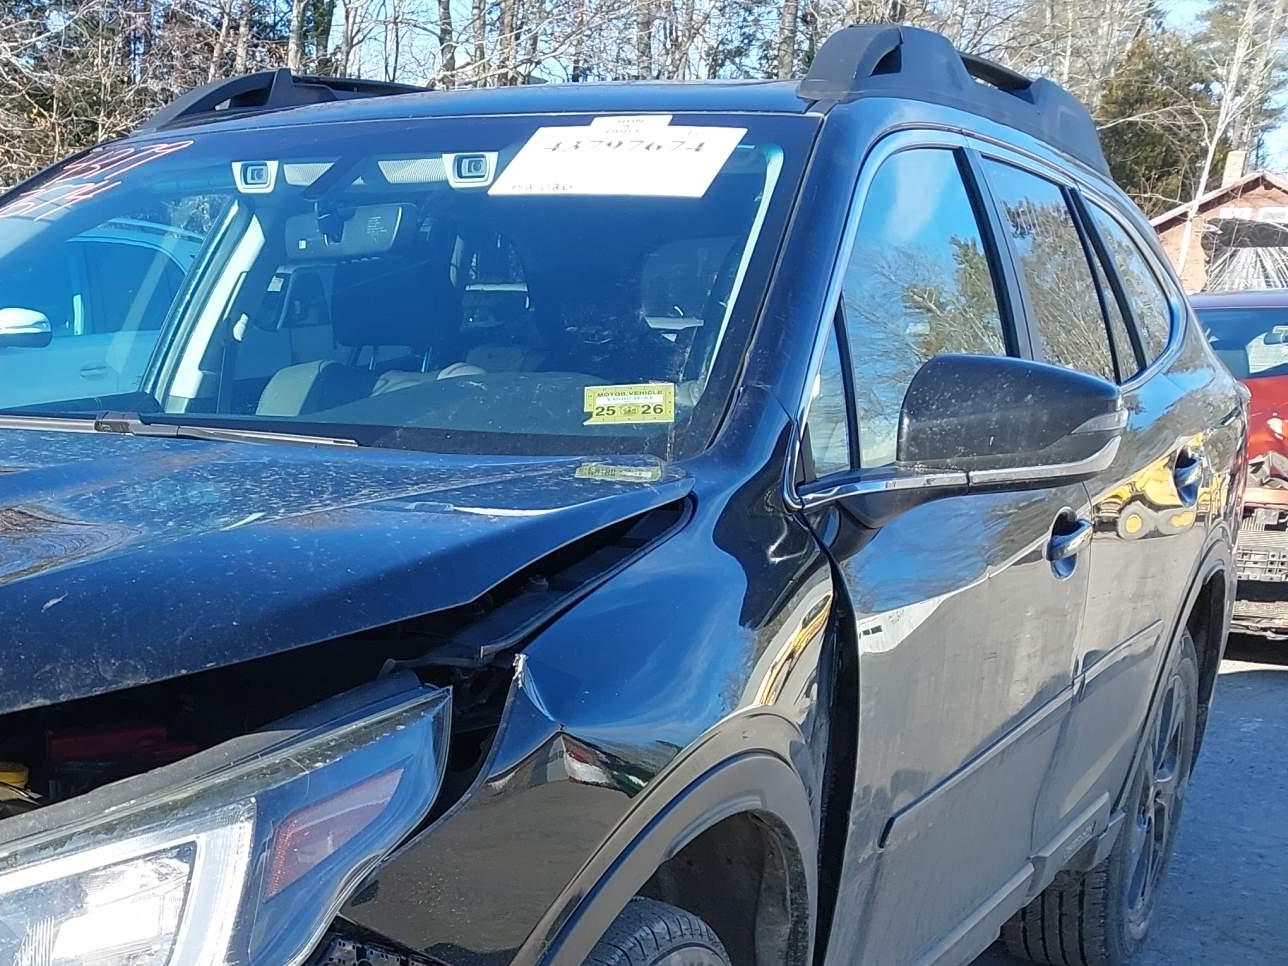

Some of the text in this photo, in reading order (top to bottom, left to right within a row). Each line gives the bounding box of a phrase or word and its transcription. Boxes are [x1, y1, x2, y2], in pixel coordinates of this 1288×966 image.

[543, 139, 706, 153] 43797674
[595, 405, 616, 417] 25
[641, 403, 664, 415] 26
